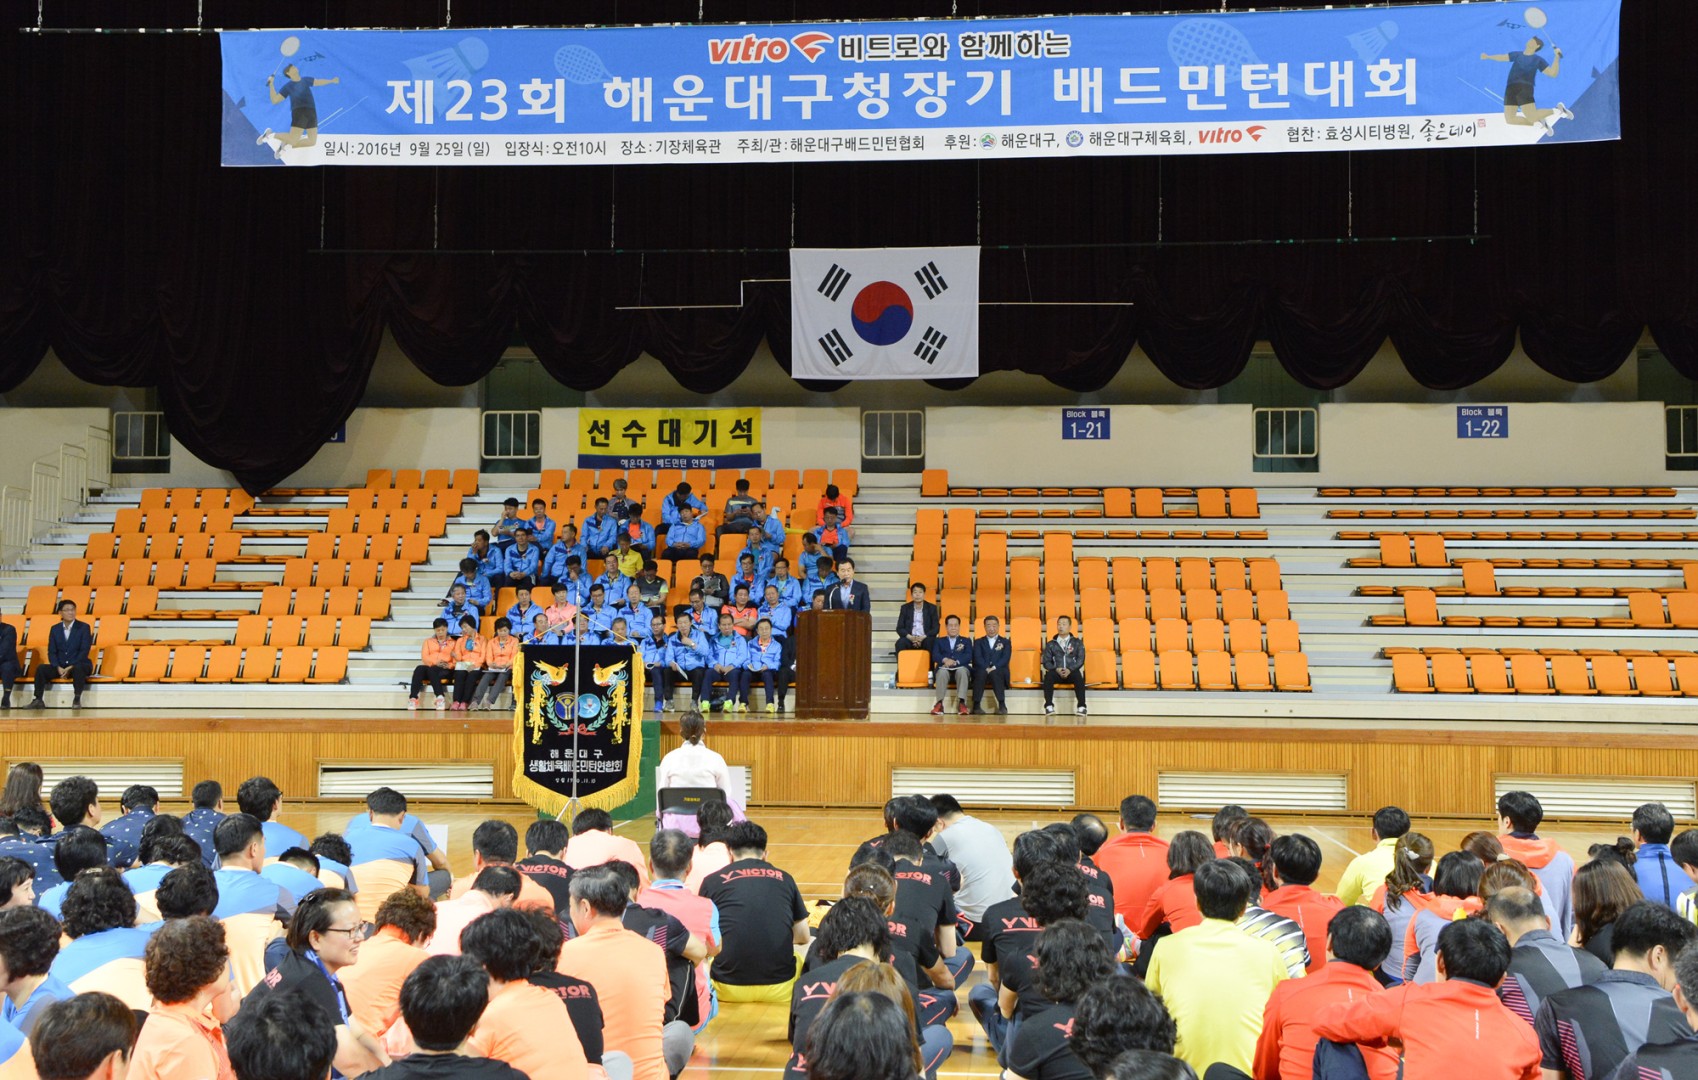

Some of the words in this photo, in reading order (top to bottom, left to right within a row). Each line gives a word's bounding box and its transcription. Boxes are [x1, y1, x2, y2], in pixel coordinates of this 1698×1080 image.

[708, 33, 790, 64] vitro
[839, 33, 950, 62] 비트로와
[960, 28, 1072, 59] 함께하는
[385, 77, 566, 124] 제23회
[602, 68, 1012, 123] 해운대구청장기
[1053, 56, 1418, 115] 배드민턴대회
[409, 141, 430, 157] 9월
[435, 141, 464, 157] 25일
[467, 141, 490, 157] (일)
[944, 133, 977, 150] 후원:
[1001, 131, 1060, 149] 해운대구,
[1089, 129, 1193, 148] 해운대구체육회,
[1198, 125, 1243, 144] vitro
[1420, 119, 1477, 142] 좋은데이
[1066, 410, 1087, 418] Block
[1461, 407, 1483, 416] Block
[587, 417, 753, 448] 선수대기석
[1070, 421, 1102, 438] 1-21
[1465, 419, 1500, 437] 1-22
[620, 458, 652, 468] 해운대구
[656, 458, 687, 468] 배드민턴
[691, 458, 715, 468] 연합회
[521, 864, 568, 878] VICTOR
[734, 868, 783, 880] VICTOR
